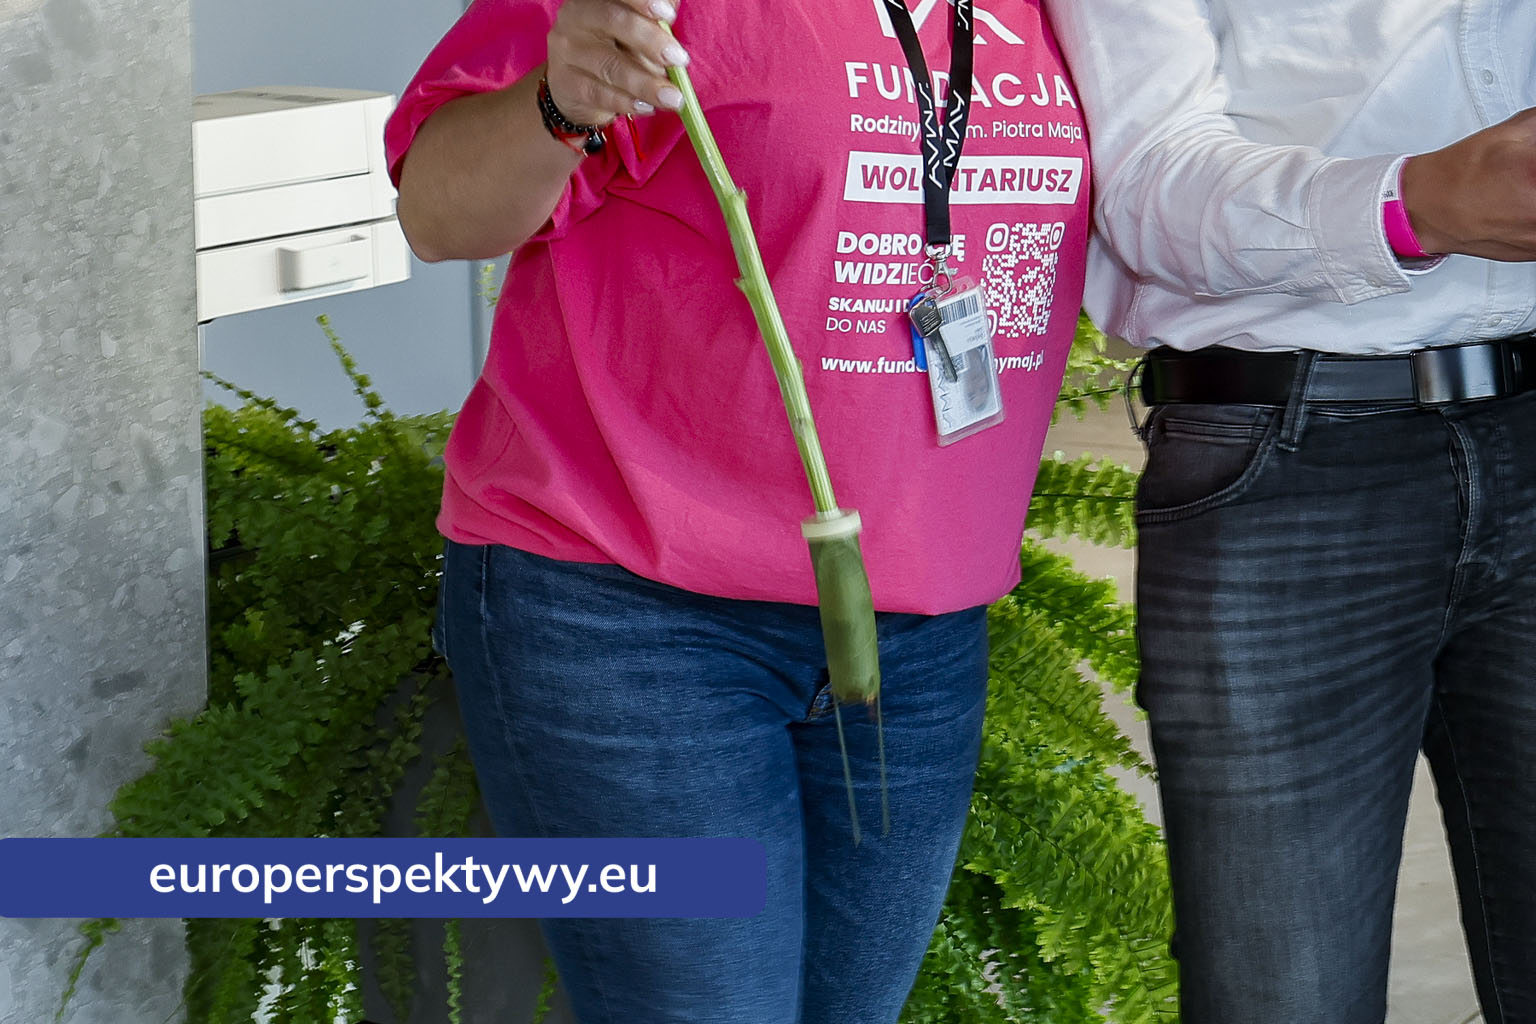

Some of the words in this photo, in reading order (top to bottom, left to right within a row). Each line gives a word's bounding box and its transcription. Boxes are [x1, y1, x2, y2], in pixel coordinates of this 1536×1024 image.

[850, 114, 920, 143] Rodziny
[992, 120, 1043, 139] Piotra
[1048, 122, 1082, 143] Maja
[861, 164, 1073, 193] WOLNTARIUSZ
[836, 231, 923, 256] DOBRO
[828, 296, 894, 313] SKANUJ
[825, 317, 851, 333] DO
[856, 319, 886, 334] NAS
